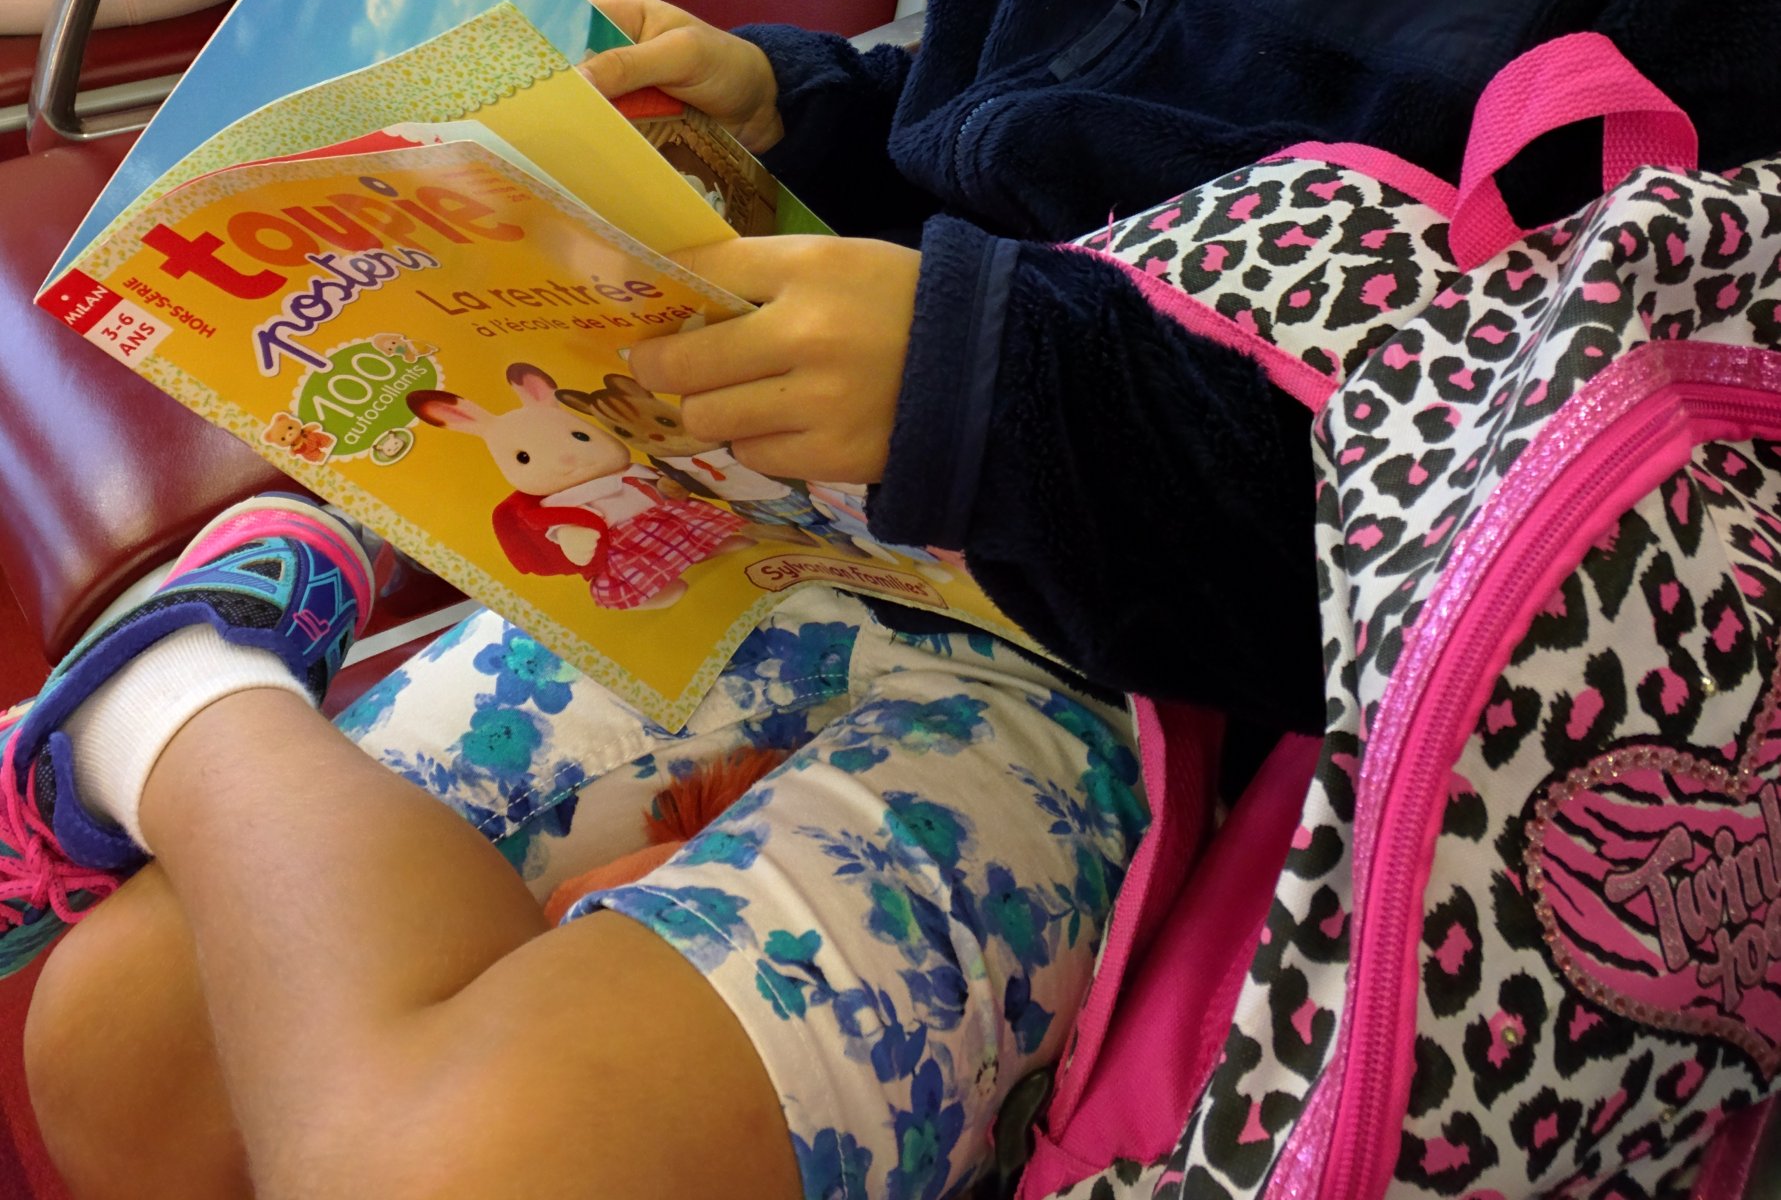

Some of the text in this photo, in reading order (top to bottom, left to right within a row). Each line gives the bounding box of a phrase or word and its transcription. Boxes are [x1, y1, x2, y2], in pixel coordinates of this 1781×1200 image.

[140, 176, 525, 300] toupie
[64, 285, 109, 325] MILAN
[257, 246, 439, 371] posters
[415, 275, 664, 316] La rentrée
[101, 312, 134, 341] 3-6
[119, 322, 155, 357] ANS
[471, 322, 497, 337] à
[489, 316, 570, 334] l'école
[571, 315, 606, 329] de
[600, 314, 634, 327] la
[312, 352, 396, 422] 100
[344, 364, 428, 445] autocollants
[761, 560, 855, 580] Sylvanian
